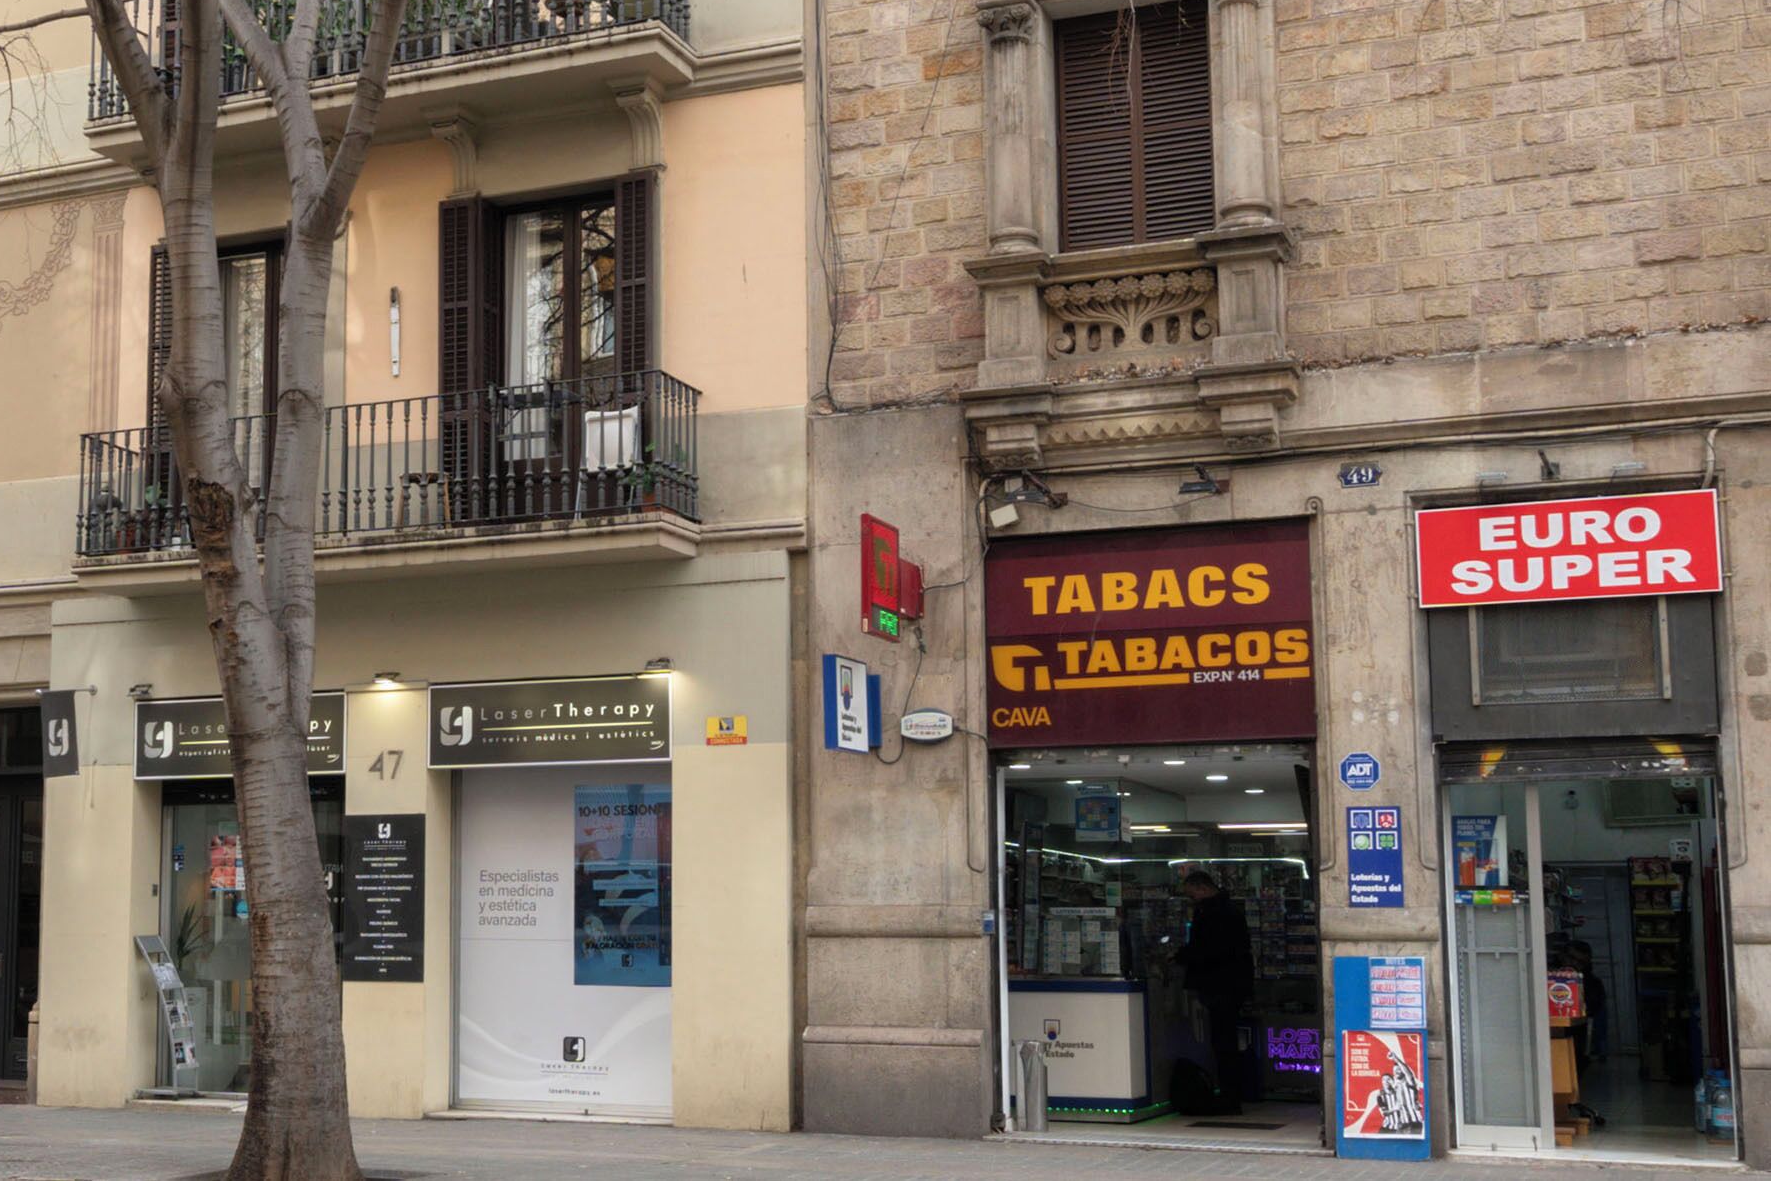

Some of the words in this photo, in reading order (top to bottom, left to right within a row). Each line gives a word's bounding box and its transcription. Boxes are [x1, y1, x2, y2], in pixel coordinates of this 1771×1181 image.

[1347, 466, 1373, 484] 49
[1478, 506, 1662, 551] EURO
[1450, 548, 1696, 595] SUPER
[1023, 562, 1271, 616] TABACS
[1057, 628, 1311, 675] TABACOS
[1237, 669, 1260, 681] 414
[992, 706, 1052, 728] CAVA
[368, 750, 404, 780] 47
[1347, 763, 1373, 776] ADT
[579, 805, 610, 817] 10+10
[479, 870, 560, 884] Especialistas
[479, 886, 494, 897] en
[497, 884, 554, 897] medicina
[1351, 884, 1387, 894] Apuestas
[1388, 884, 1402, 892] del
[1351, 895, 1379, 903] Estado
[478, 901, 486, 914] y
[488, 899, 537, 912] estética
[478, 914, 537, 926] avanzada
[1054, 1040, 1094, 1050] Apuestas
[1045, 1050, 1075, 1059] Estado
